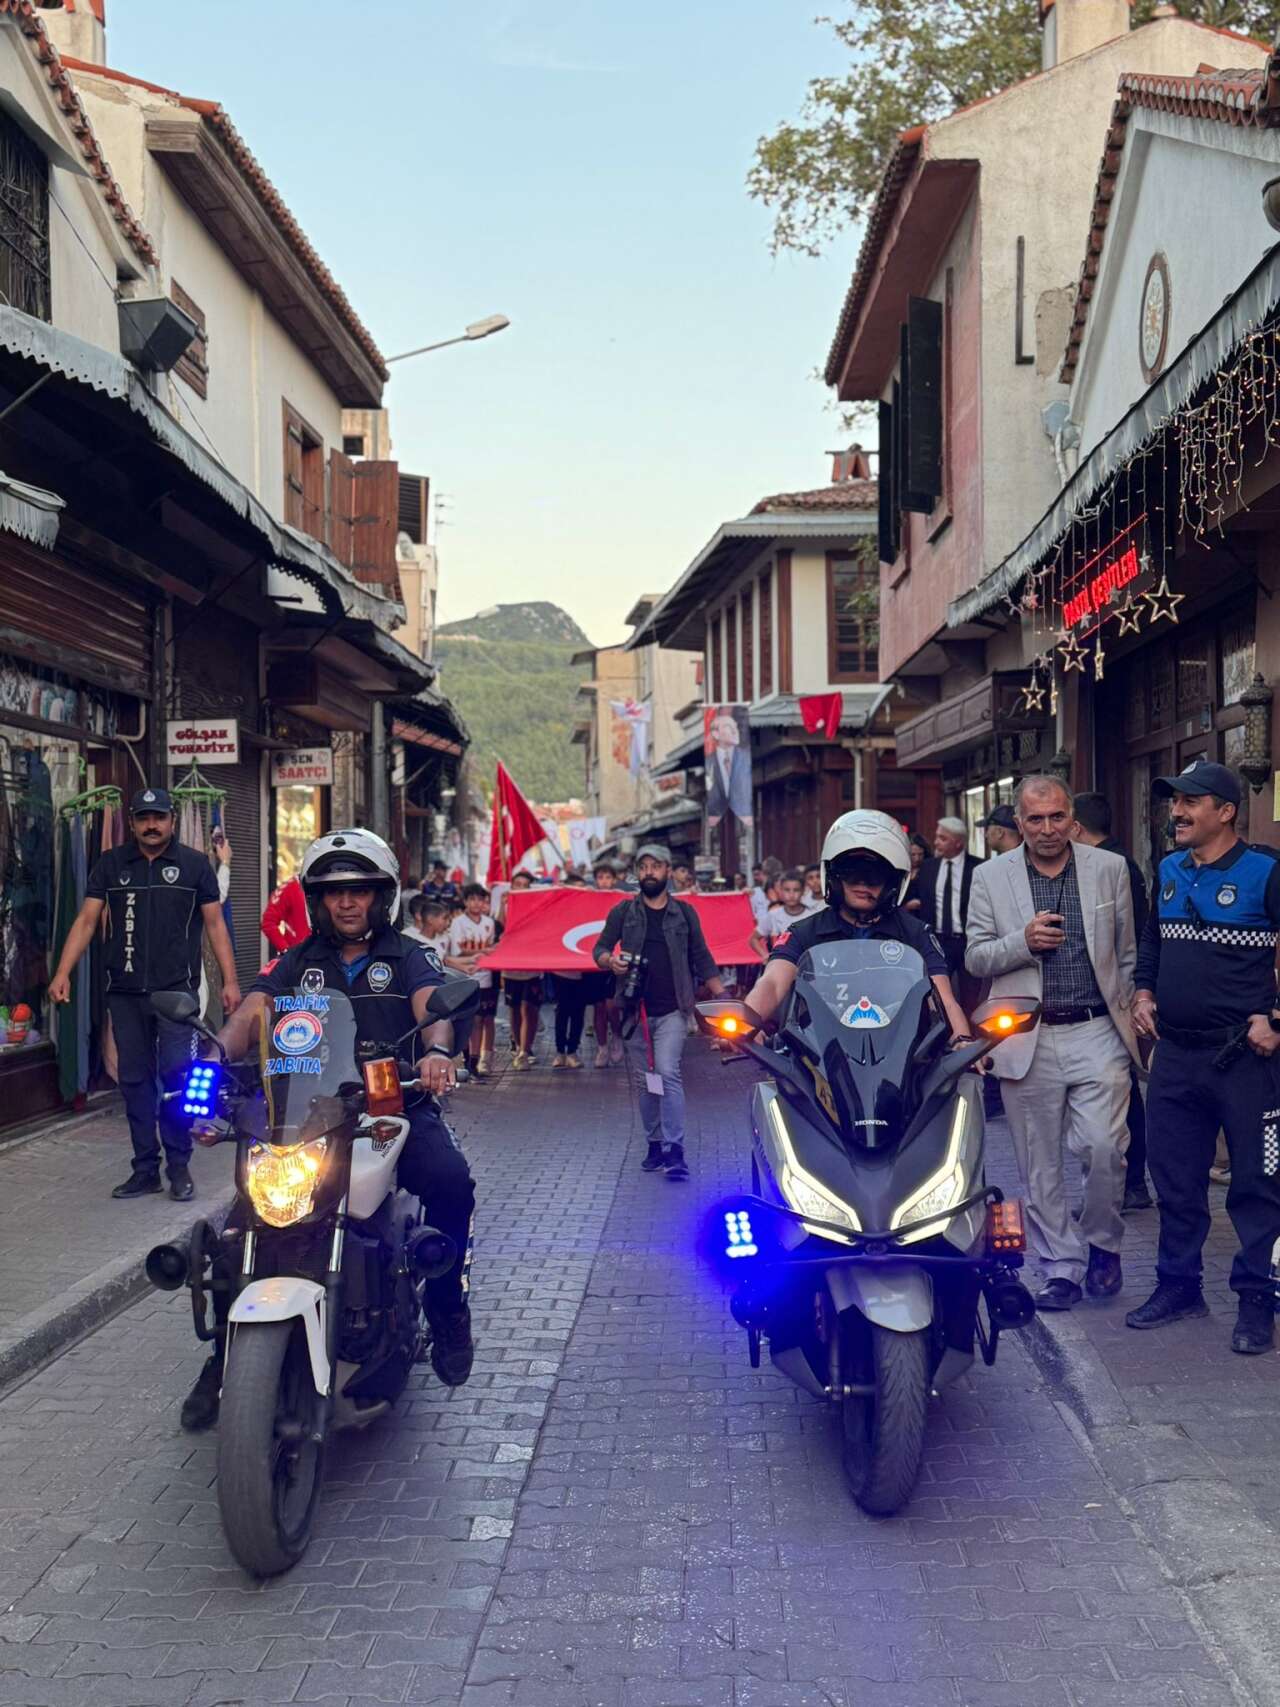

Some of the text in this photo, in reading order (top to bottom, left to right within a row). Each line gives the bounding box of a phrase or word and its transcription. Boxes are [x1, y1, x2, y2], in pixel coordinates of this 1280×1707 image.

[124, 892, 136, 973] ZABITA
[264, 1056, 322, 1076] ZABITA
[854, 1119, 889, 1127] HONDA
